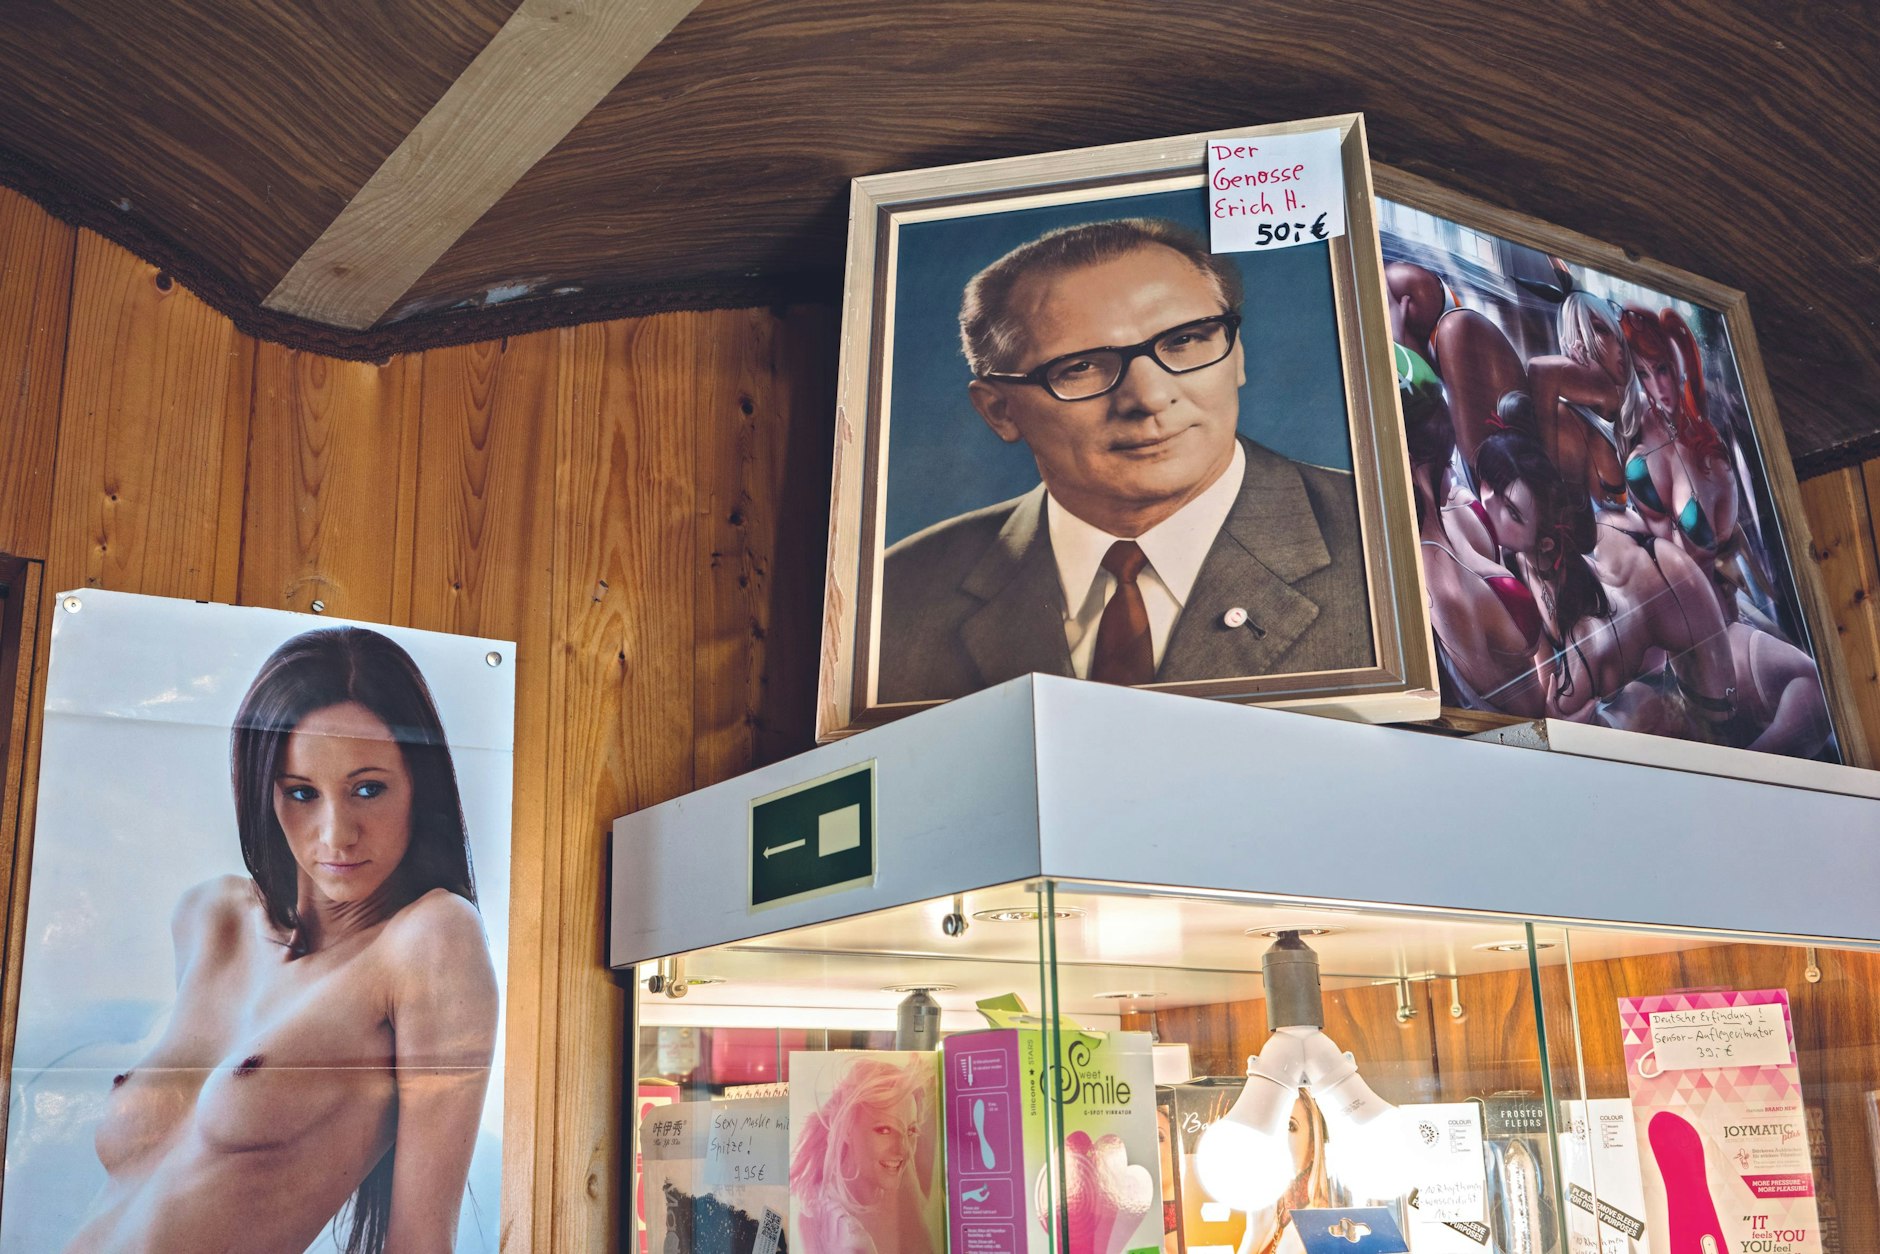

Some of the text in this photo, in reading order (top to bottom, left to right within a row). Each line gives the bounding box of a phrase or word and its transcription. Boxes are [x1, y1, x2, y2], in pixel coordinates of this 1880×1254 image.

[1211, 145, 1259, 161] Der
[1213, 164, 1305, 191] Genosse
[1214, 189, 1306, 219] Erich H.
[1653, 1014, 1696, 1024] Deutsche
[1700, 1009, 1753, 1025] Erfindung
[1500, 1109, 1543, 1118] FROSTED
[714, 1115, 737, 1137] Sexy
[1505, 1119, 1541, 1127] FLEURS
[1723, 1123, 1794, 1138] JOYMATIC
[1604, 1215, 1638, 1237] PURPOSES
[1616, 1214, 1641, 1231] SLEEVE
[1752, 1229, 1806, 1242] feels YOU
[1740, 1240, 1791, 1253] YOU feel
